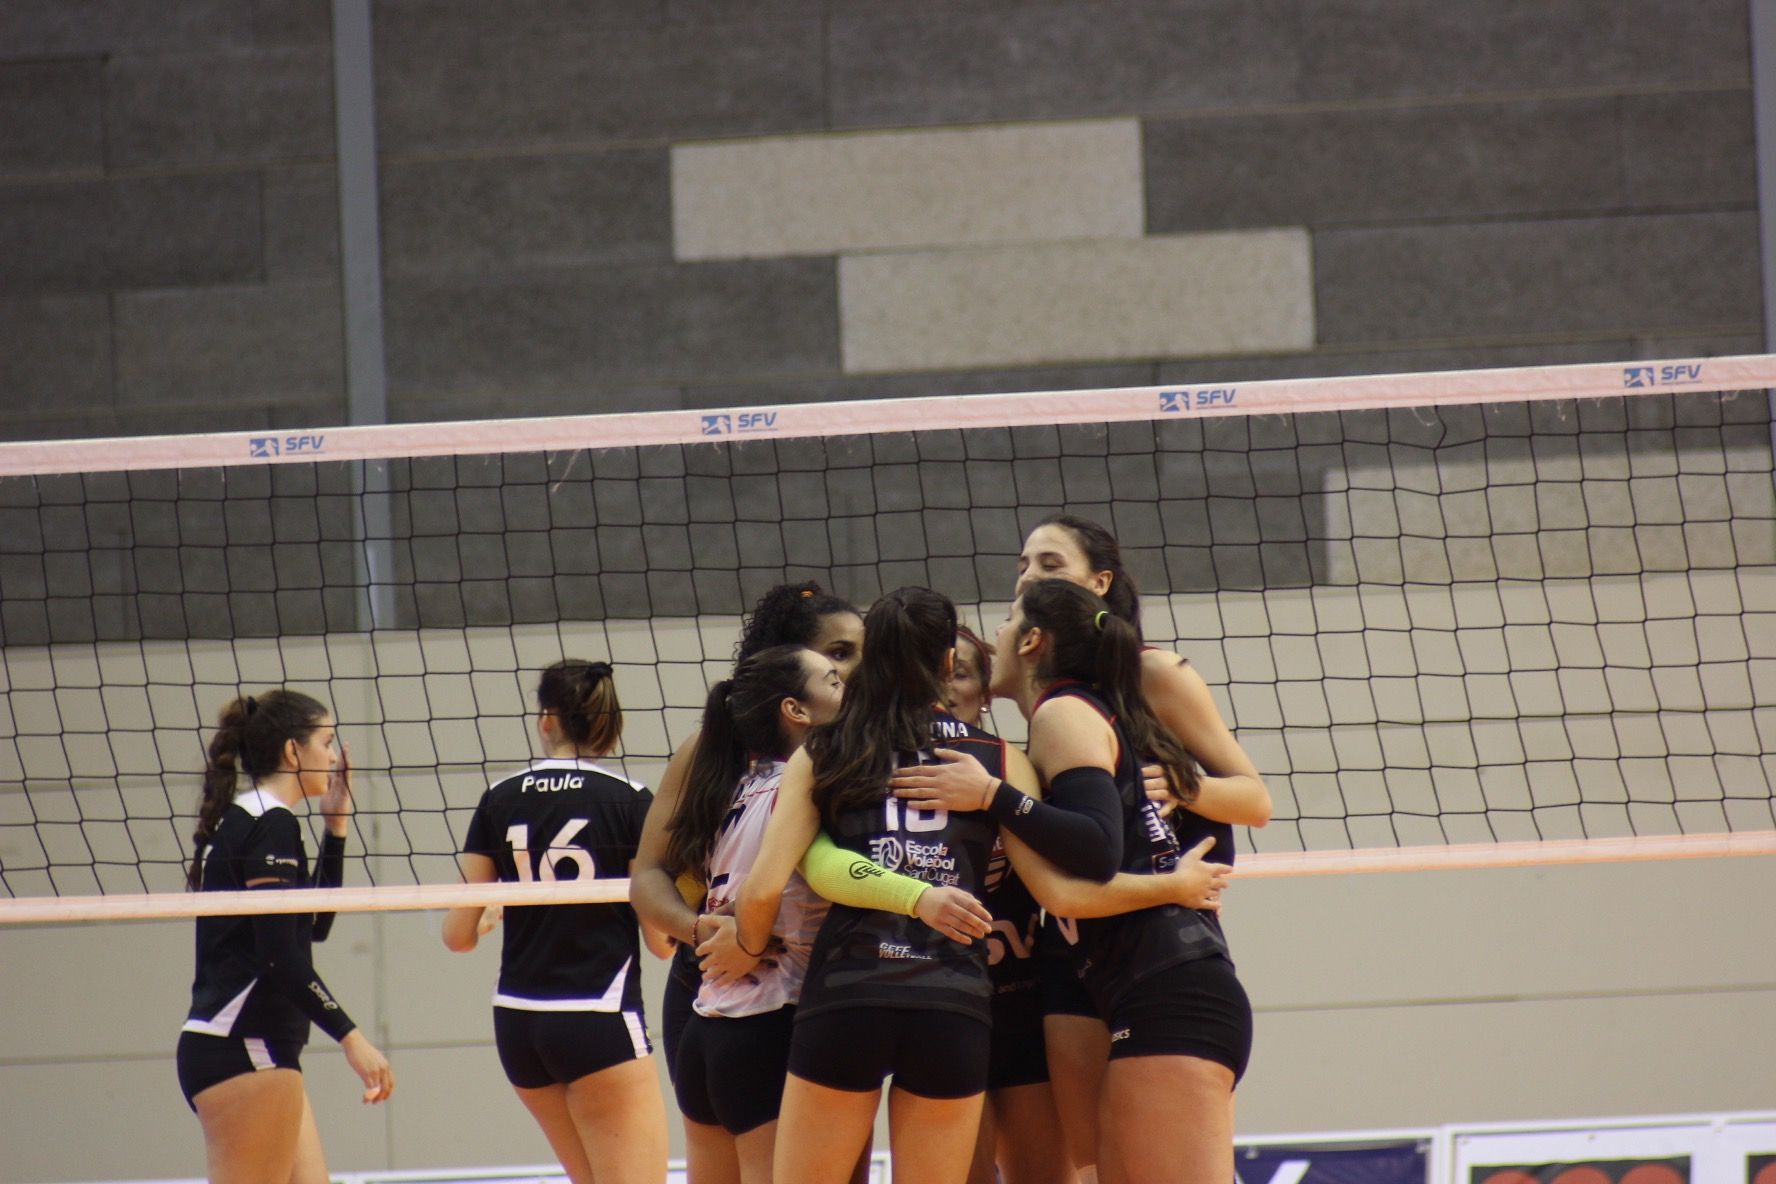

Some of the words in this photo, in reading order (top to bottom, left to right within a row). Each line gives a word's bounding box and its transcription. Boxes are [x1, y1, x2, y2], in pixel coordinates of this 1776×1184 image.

[1661, 364, 1701, 380] SFV
[1196, 388, 1236, 404] SFV
[738, 412, 777, 428] SFV
[285, 435, 324, 451] SFV
[521, 773, 585, 793] Paula
[505, 818, 596, 882] 16
[905, 839, 949, 856] Escola
